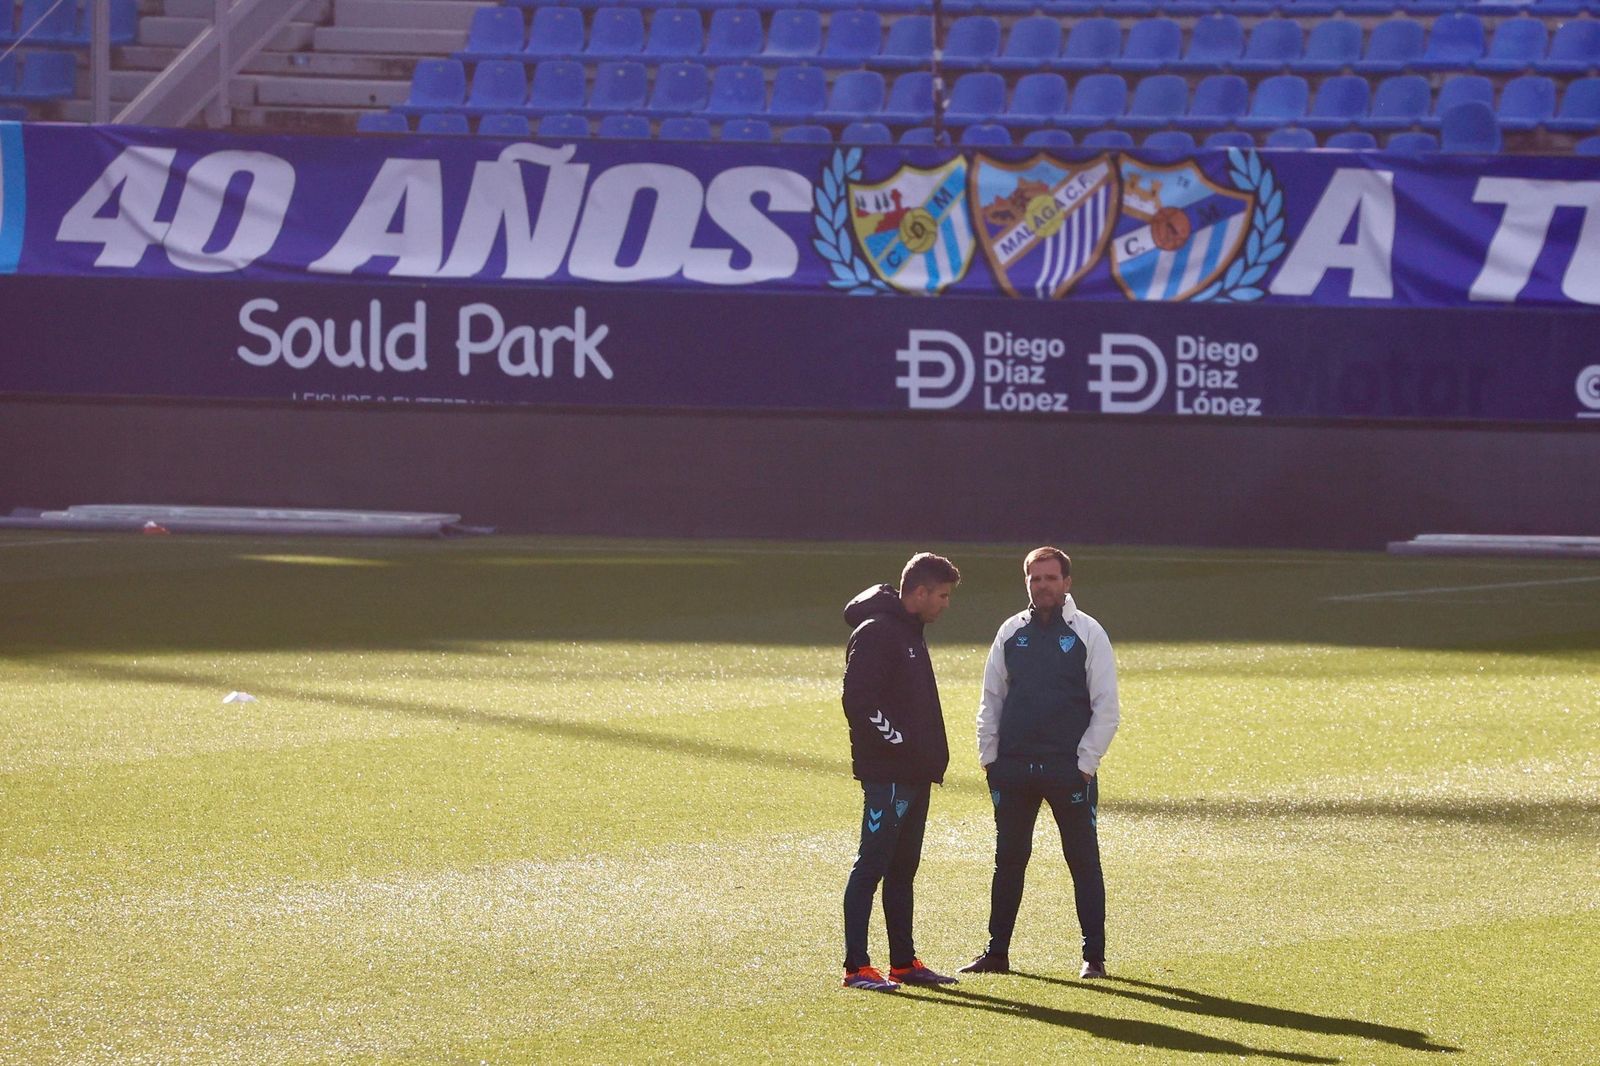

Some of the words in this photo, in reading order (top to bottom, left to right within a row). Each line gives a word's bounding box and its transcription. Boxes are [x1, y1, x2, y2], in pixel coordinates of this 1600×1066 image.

[56, 146, 295, 272] 40
[308, 142, 813, 284] AÑOS
[1269, 168, 1396, 298] A
[237, 298, 428, 372] Sould
[456, 303, 614, 380] Park
[984, 331, 1065, 362] Diego
[1176, 335, 1259, 367] Diego
[984, 359, 1046, 384] Díaz
[1176, 363, 1239, 389] Díaz
[984, 386, 1068, 411] López
[1176, 390, 1262, 416] López
